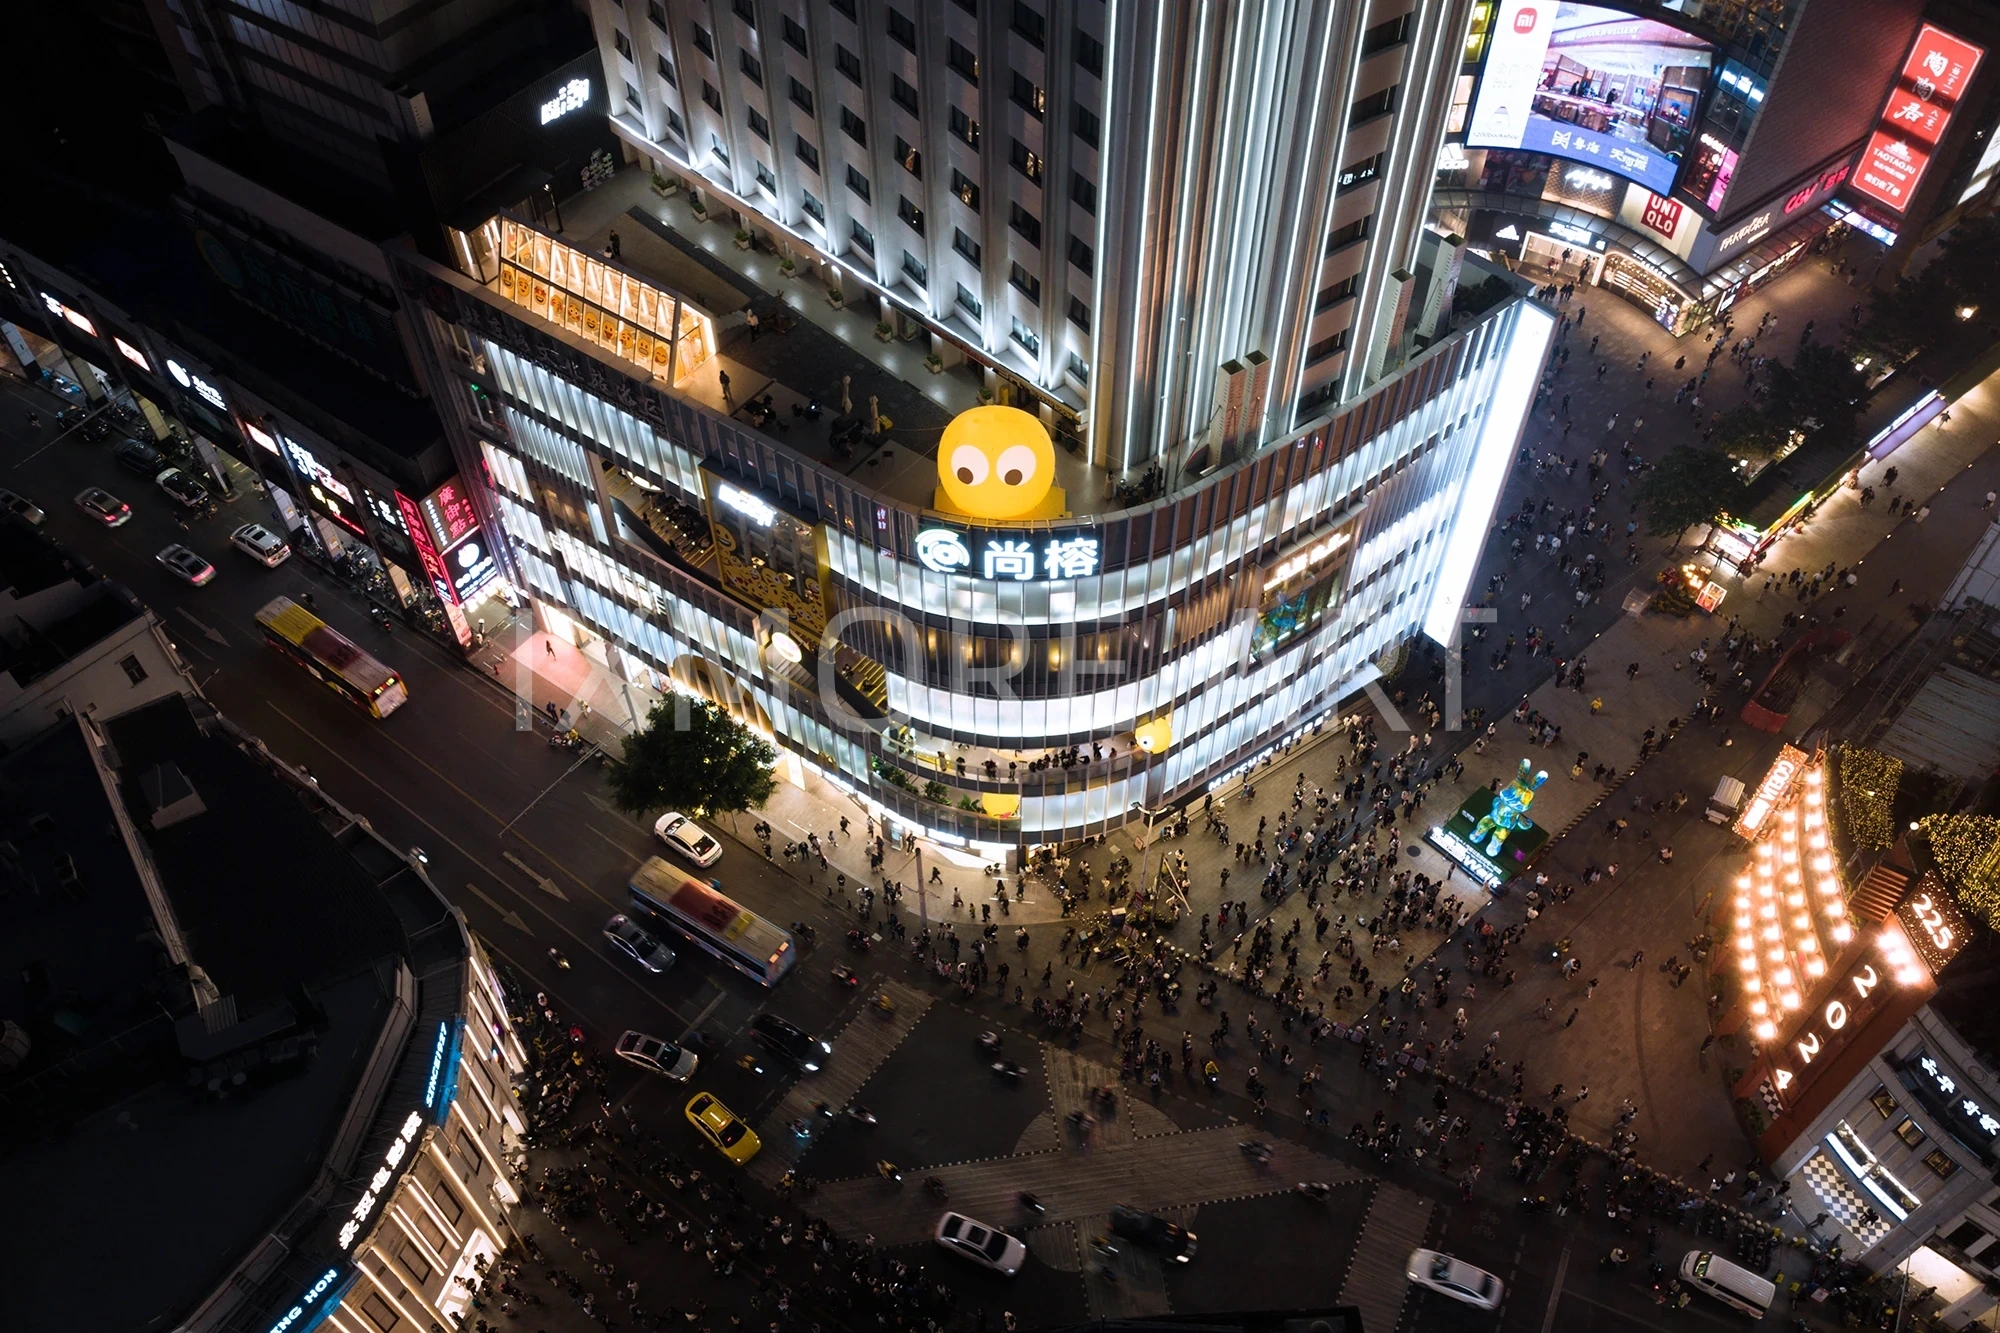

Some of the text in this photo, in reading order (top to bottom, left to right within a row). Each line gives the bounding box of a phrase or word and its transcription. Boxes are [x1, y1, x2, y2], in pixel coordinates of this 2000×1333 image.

[1893, 50, 1948, 123] 陶陶居
[1873, 148, 1916, 175] TAOTAOJU
[1651, 194, 1677, 219] UNI
[1784, 183, 1818, 214] CGV
[1647, 210, 1673, 233] QLO
[1720, 213, 1771, 251] PANDORA
[984, 537, 1099, 580] 尚榕
[1461, 855, 1503, 889] Walk
[1912, 893, 1954, 949] 225
